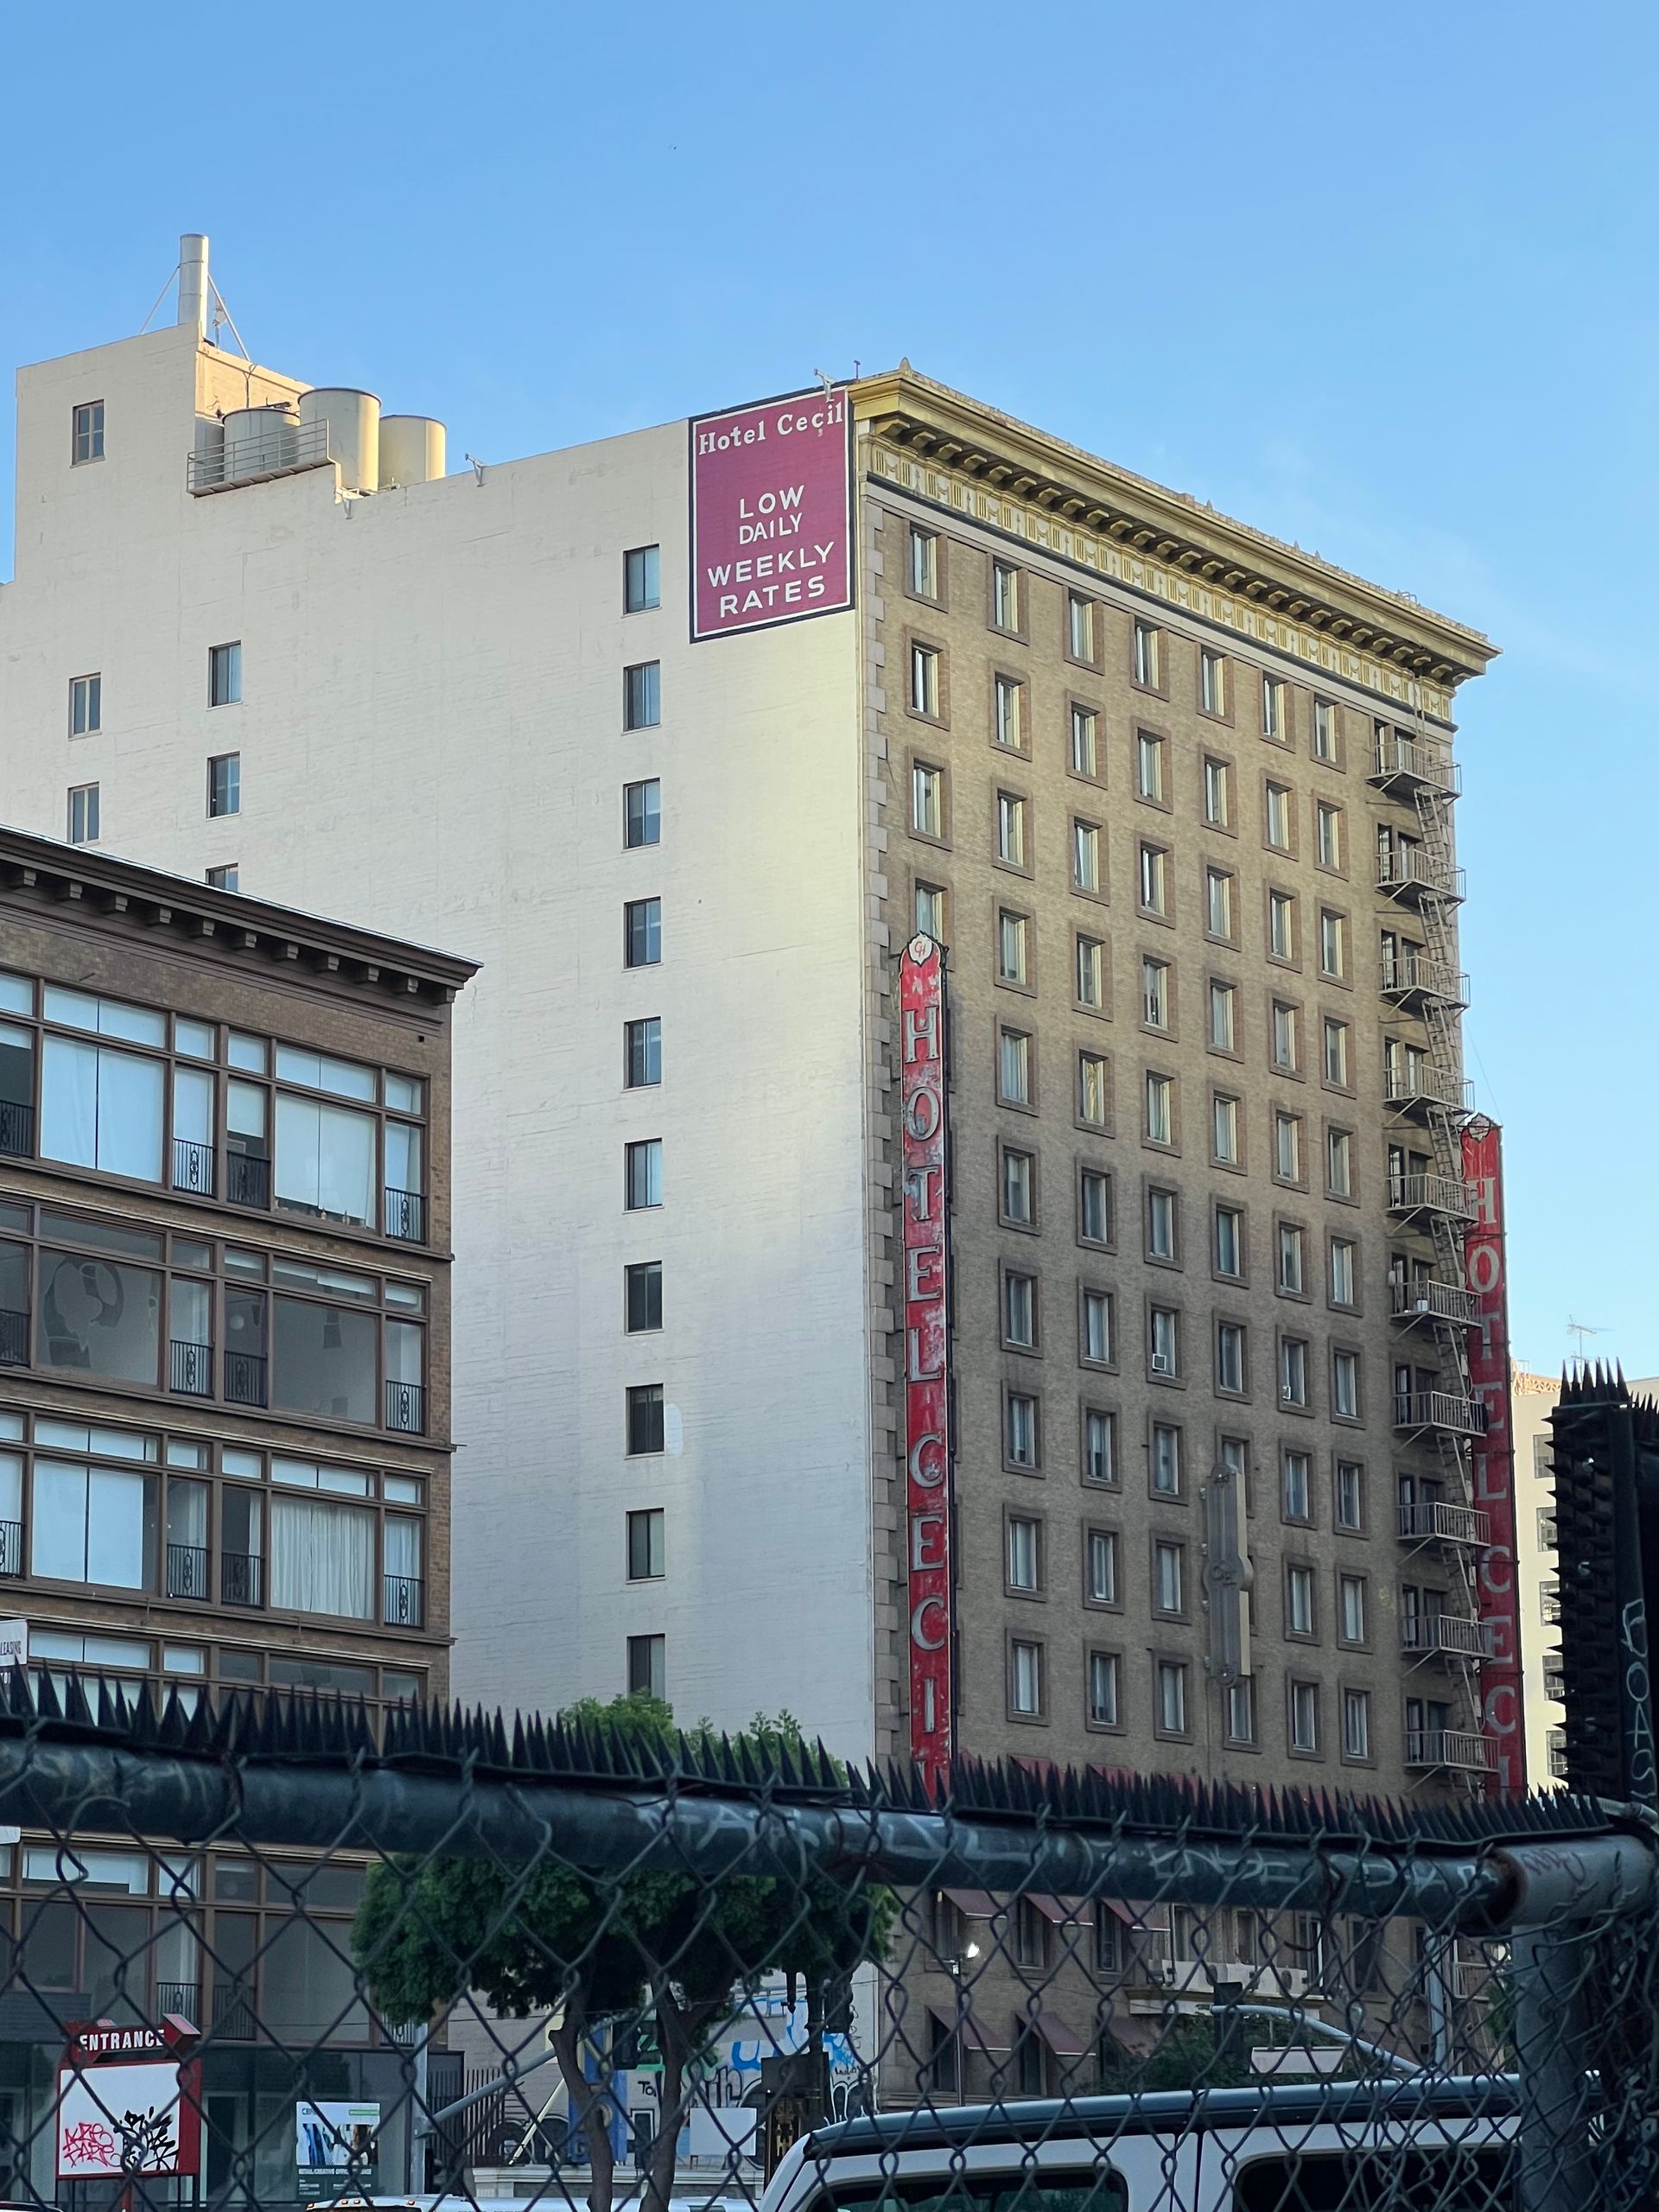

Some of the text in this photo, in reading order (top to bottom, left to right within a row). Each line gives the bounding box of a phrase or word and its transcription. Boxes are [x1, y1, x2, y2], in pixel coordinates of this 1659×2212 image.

[698, 401, 844, 455] Hotel Cecil
[740, 485, 804, 519] LOW
[740, 512, 802, 545] DAILY
[708, 541, 834, 588] WEEKLY
[720, 575, 825, 619] RATES
[904, 1005, 943, 1380] HOTEL
[1467, 1176, 1507, 1501] HOTEL
[909, 1433, 945, 1783] CECI
[79, 2029, 165, 2051] ENTRANCE
